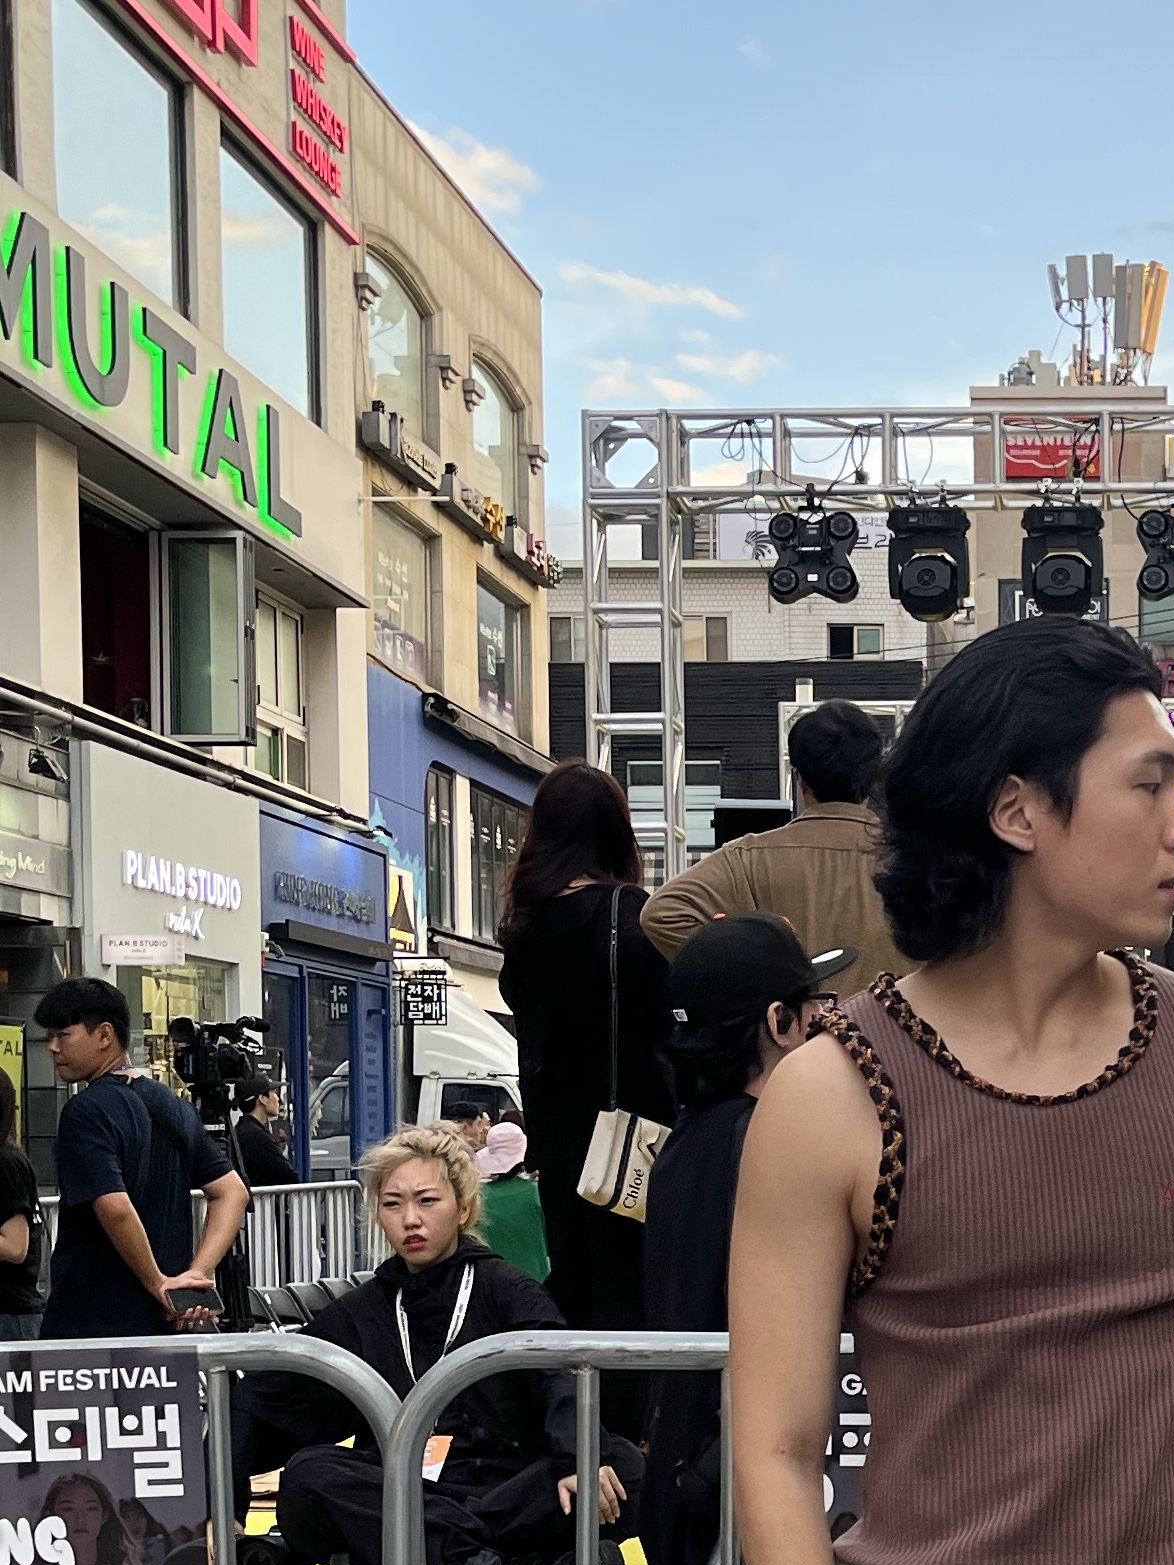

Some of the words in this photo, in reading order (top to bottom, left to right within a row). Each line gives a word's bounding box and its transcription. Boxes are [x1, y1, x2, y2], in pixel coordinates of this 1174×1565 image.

[289, 16, 327, 84] WINE
[291, 69, 349, 154] WHISKEY
[292, 121, 344, 198] LOUNGE
[187, 866, 242, 911] STUDIO
[406, 984, 440, 1001] 전자
[407, 1001, 441, 1020] 담배
[622, 1168, 645, 1210] Chloé
[39, 1366, 177, 1393] FESTIVAL
